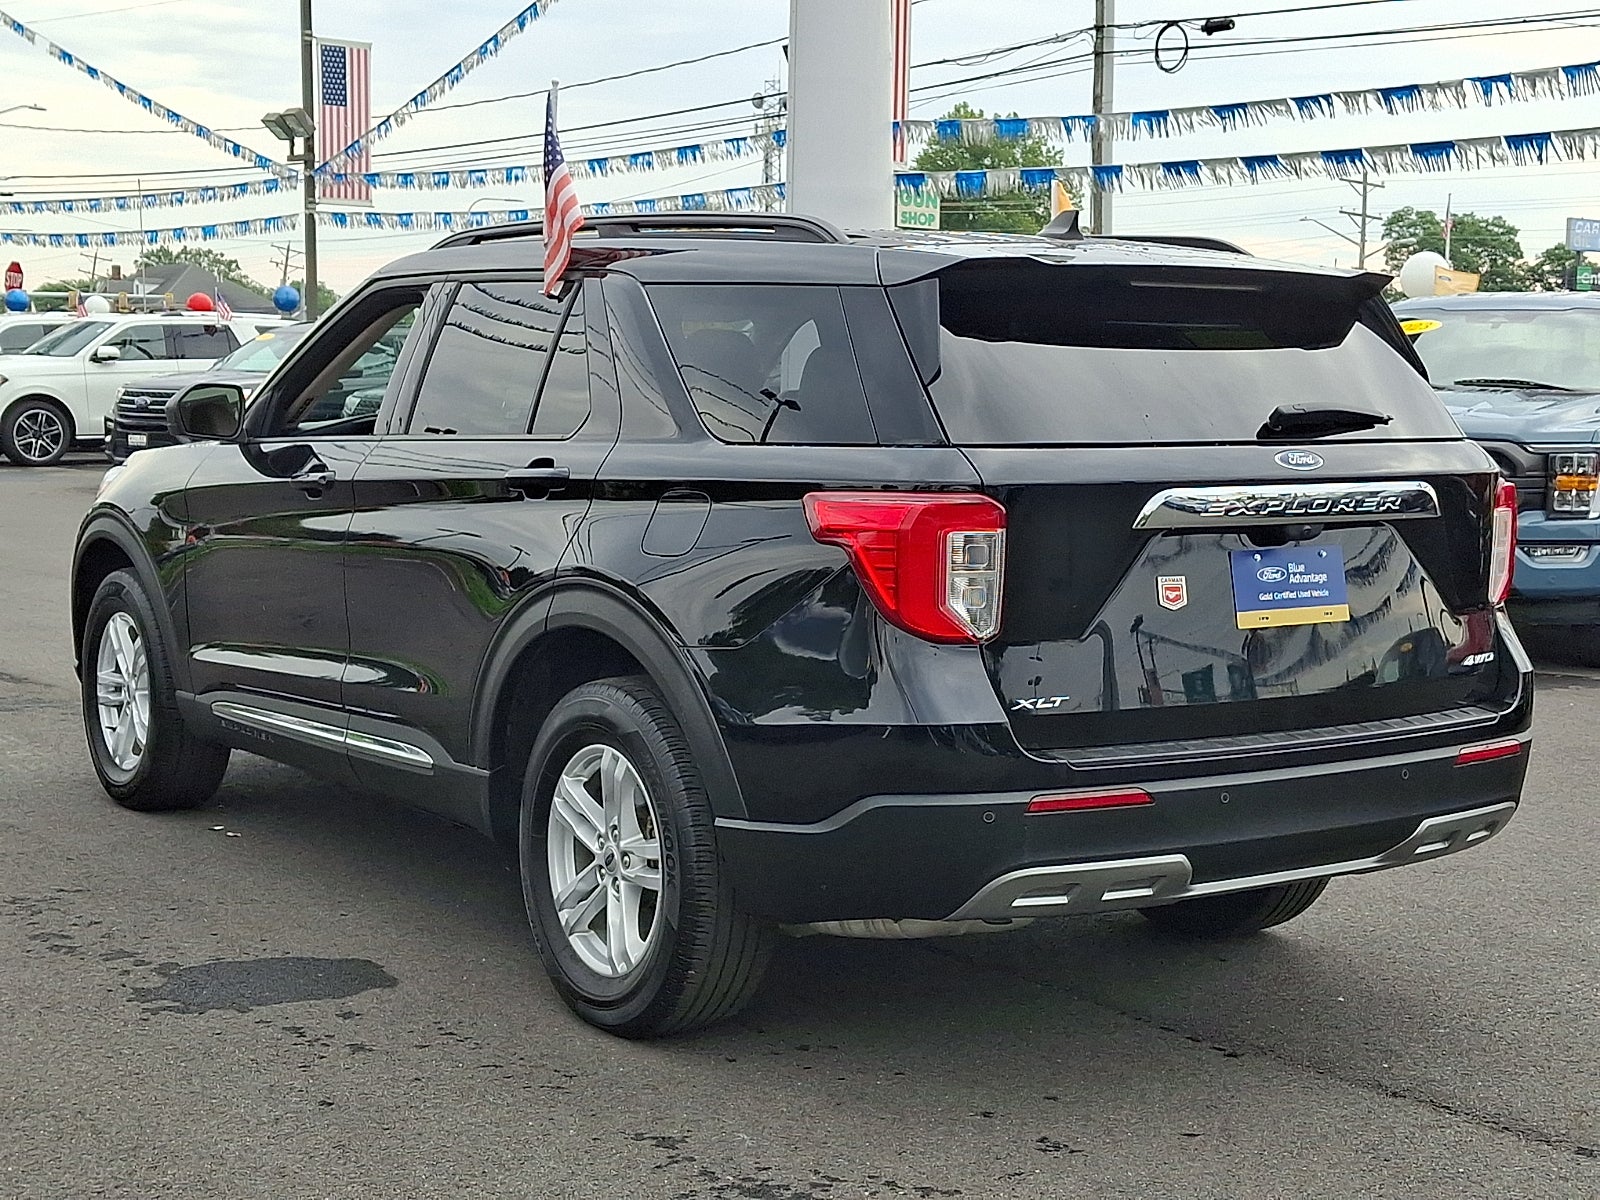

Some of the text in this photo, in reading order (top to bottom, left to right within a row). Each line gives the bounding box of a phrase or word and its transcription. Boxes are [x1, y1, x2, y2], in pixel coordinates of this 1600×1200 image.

[899, 182, 938, 209] GUN
[900, 211, 936, 227] SHOP
[5, 271, 23, 289] STOP
[1200, 496, 1402, 517] EXPLORER
[1287, 562, 1306, 573] Blue
[1289, 573, 1328, 584] Advantage
[1258, 588, 1330, 601] Gold Certified Used Vehicle
[1460, 651, 1495, 666] 4WD
[1010, 696, 1070, 711] XLT
